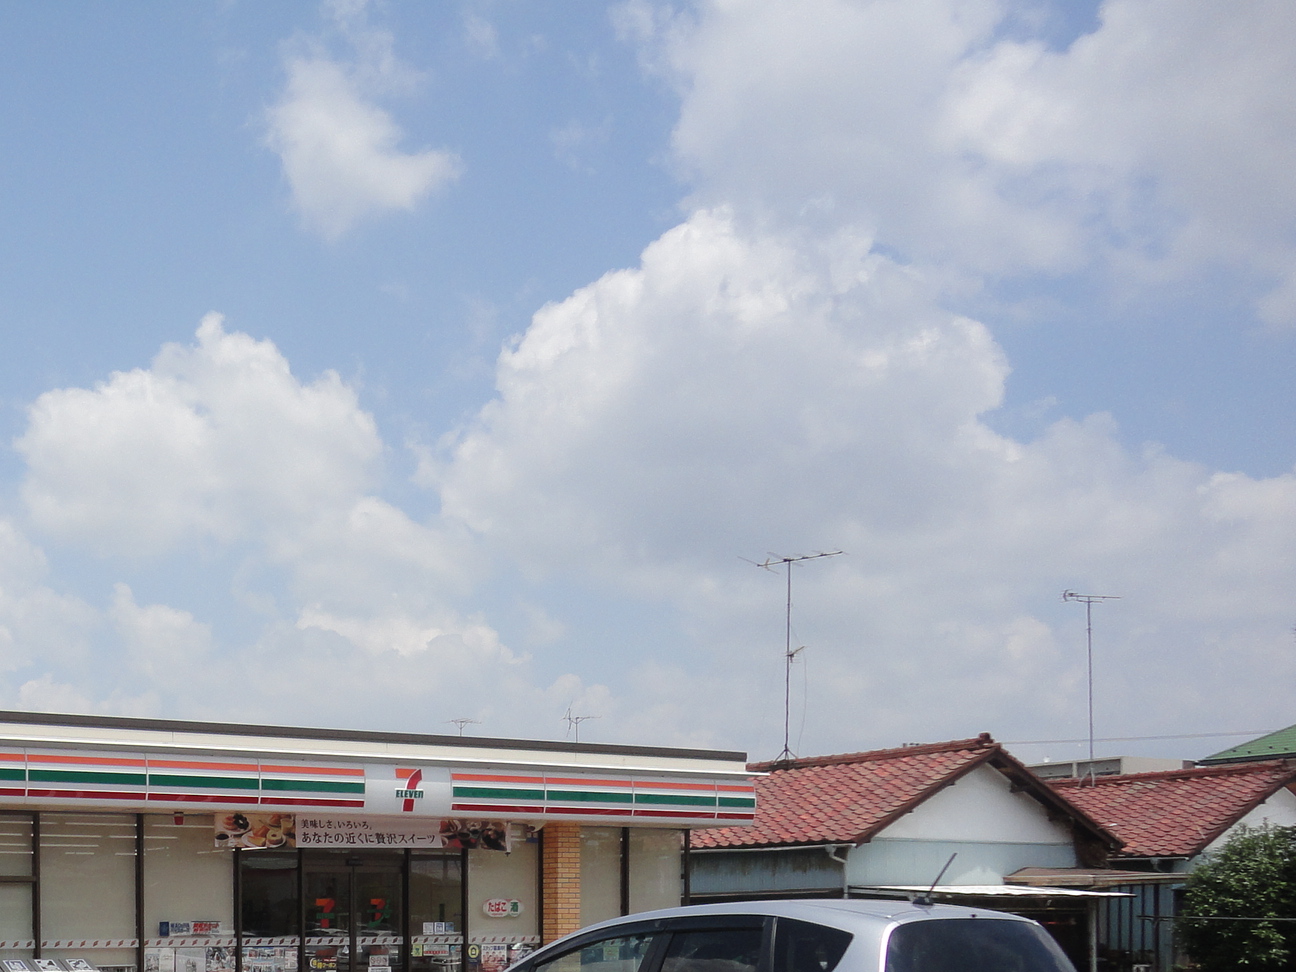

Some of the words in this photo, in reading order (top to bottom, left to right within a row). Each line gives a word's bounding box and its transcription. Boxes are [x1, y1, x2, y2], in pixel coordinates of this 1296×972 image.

[301, 831, 435, 845] あなたの近くに贅沢スイーツ
[487, 902, 508, 913] たばこ
[510, 901, 519, 912] 酒
